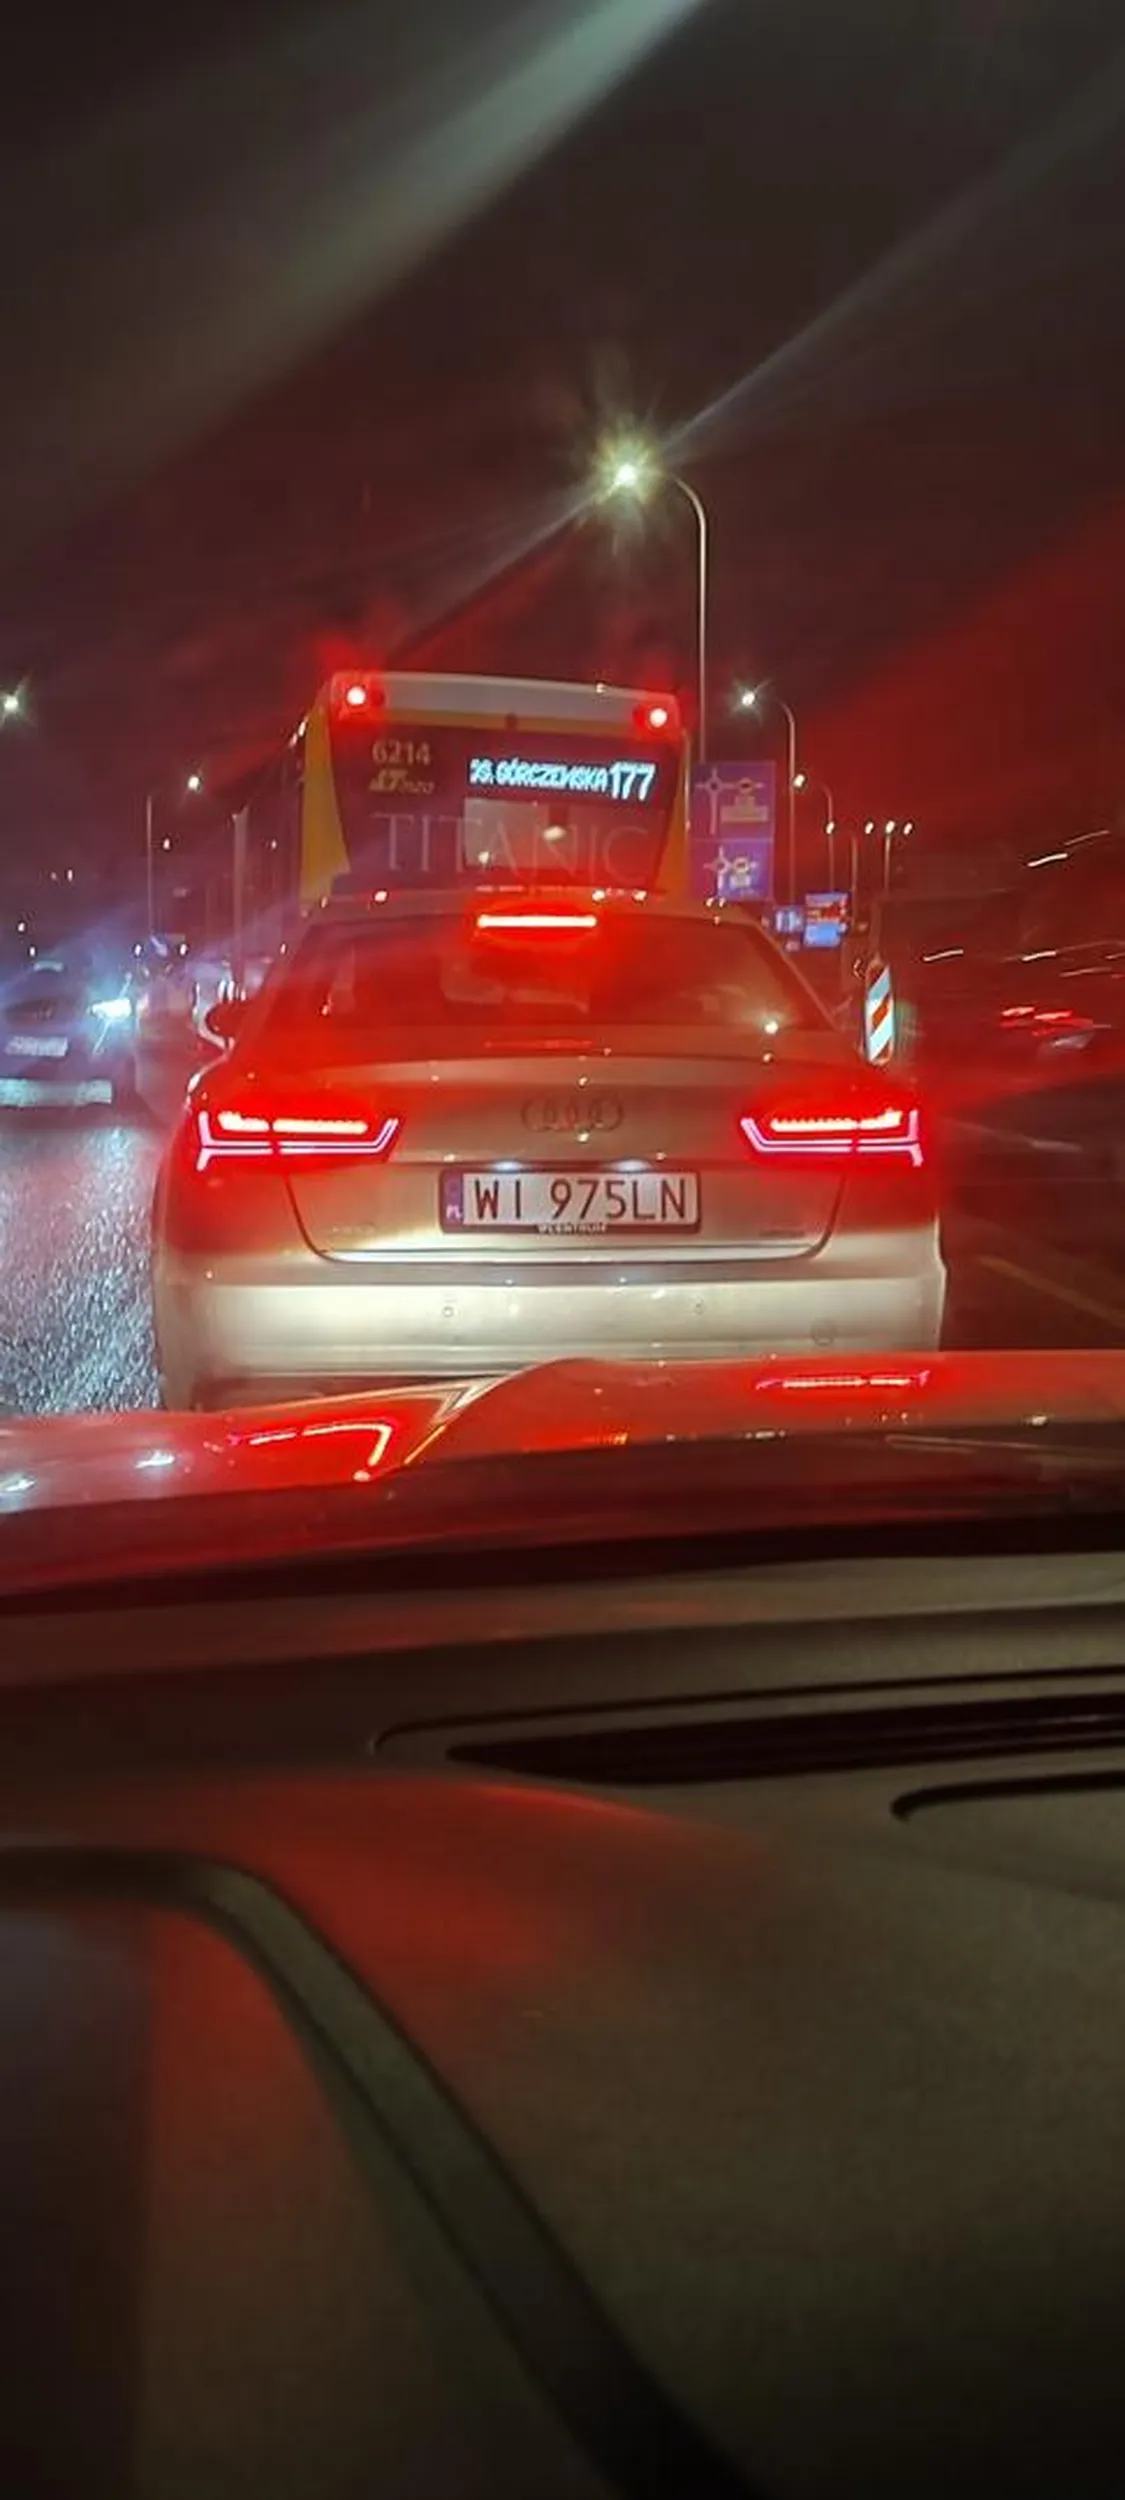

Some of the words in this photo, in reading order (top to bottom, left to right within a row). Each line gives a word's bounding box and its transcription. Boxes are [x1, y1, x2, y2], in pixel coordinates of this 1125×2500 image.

[372, 739, 431, 765] 6214
[609, 761, 656, 800] 177
[370, 811, 650, 881] TITANIC
[474, 1179, 521, 1219] WI
[550, 1178, 687, 1220] 975LN
